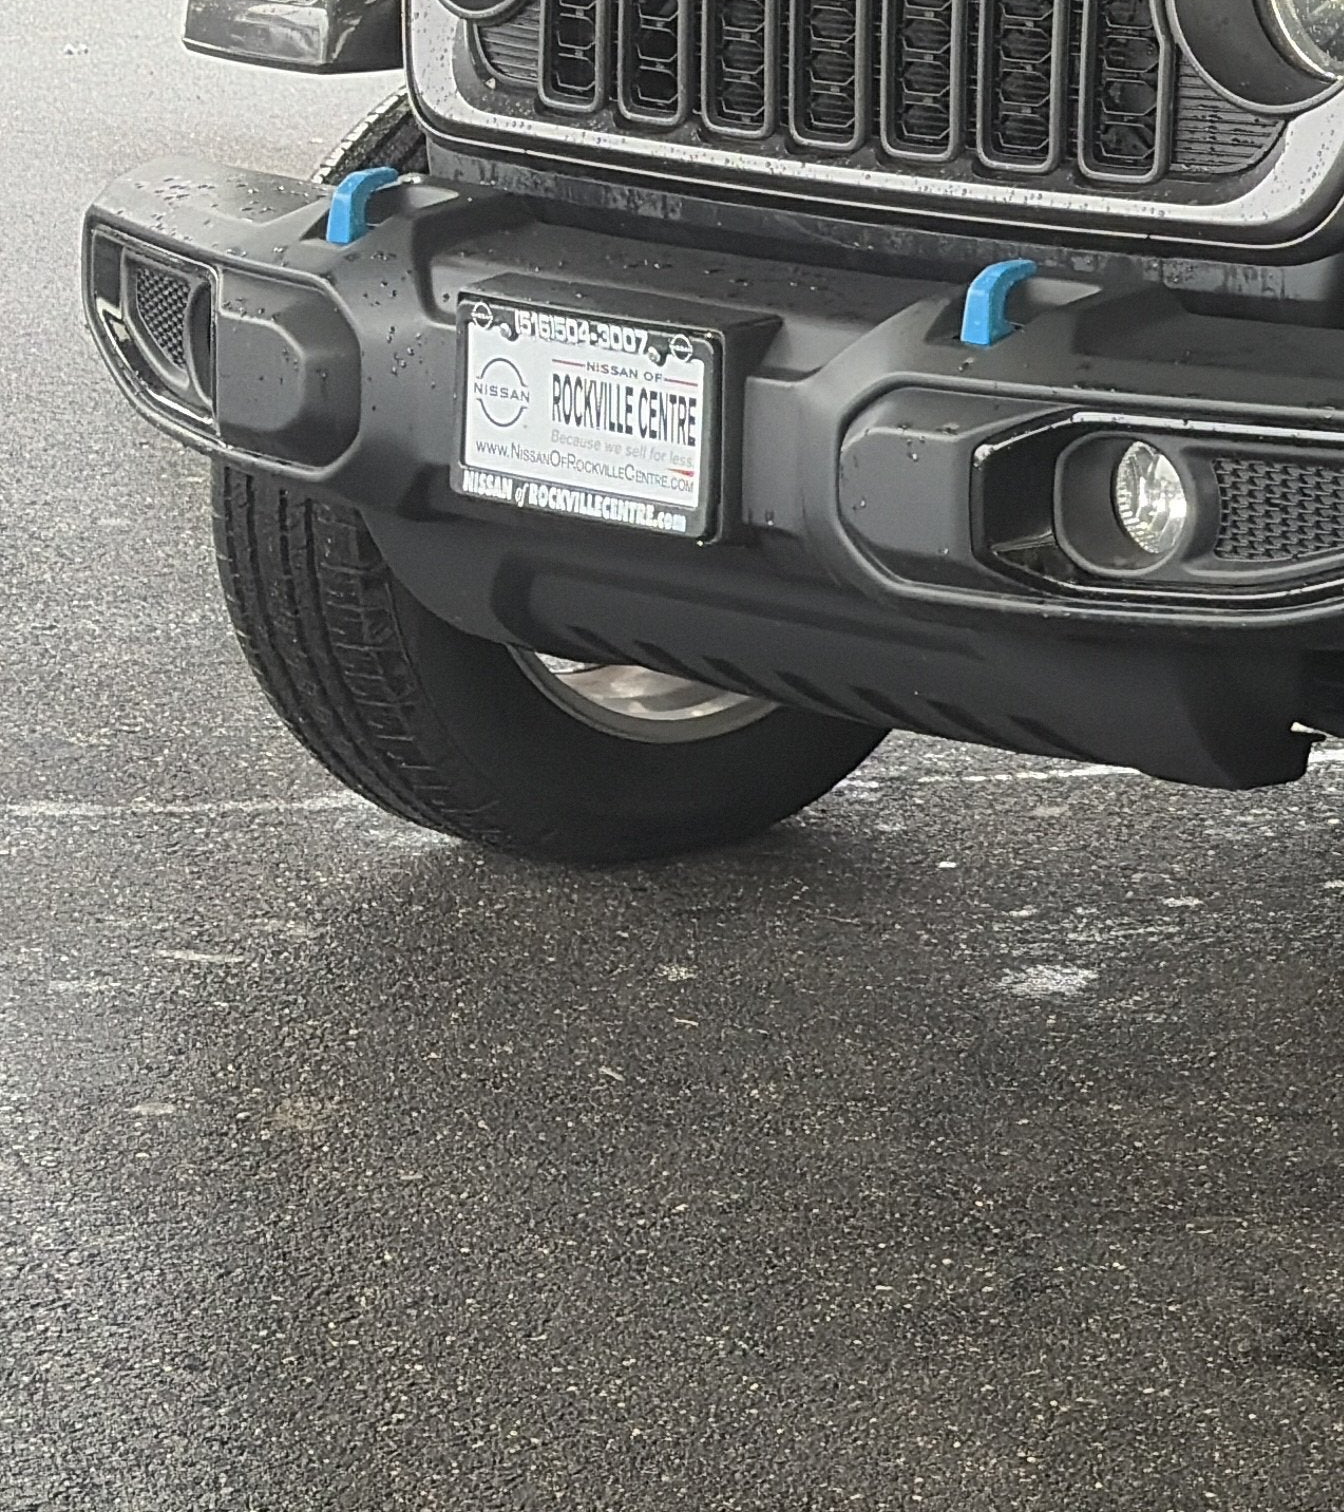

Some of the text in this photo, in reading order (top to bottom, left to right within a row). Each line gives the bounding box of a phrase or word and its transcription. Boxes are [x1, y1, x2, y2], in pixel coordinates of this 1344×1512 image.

[586, 360, 664, 384] NISSAN OF
[473, 382, 531, 403] NISSAN
[552, 373, 697, 447] ROCKVILLE CENTRE
[550, 429, 602, 451] Because
[605, 442, 622, 456] we
[626, 442, 647, 460] sell
[650, 444, 666, 462] for
[462, 470, 513, 501] NISSAN
[514, 483, 529, 508] of
